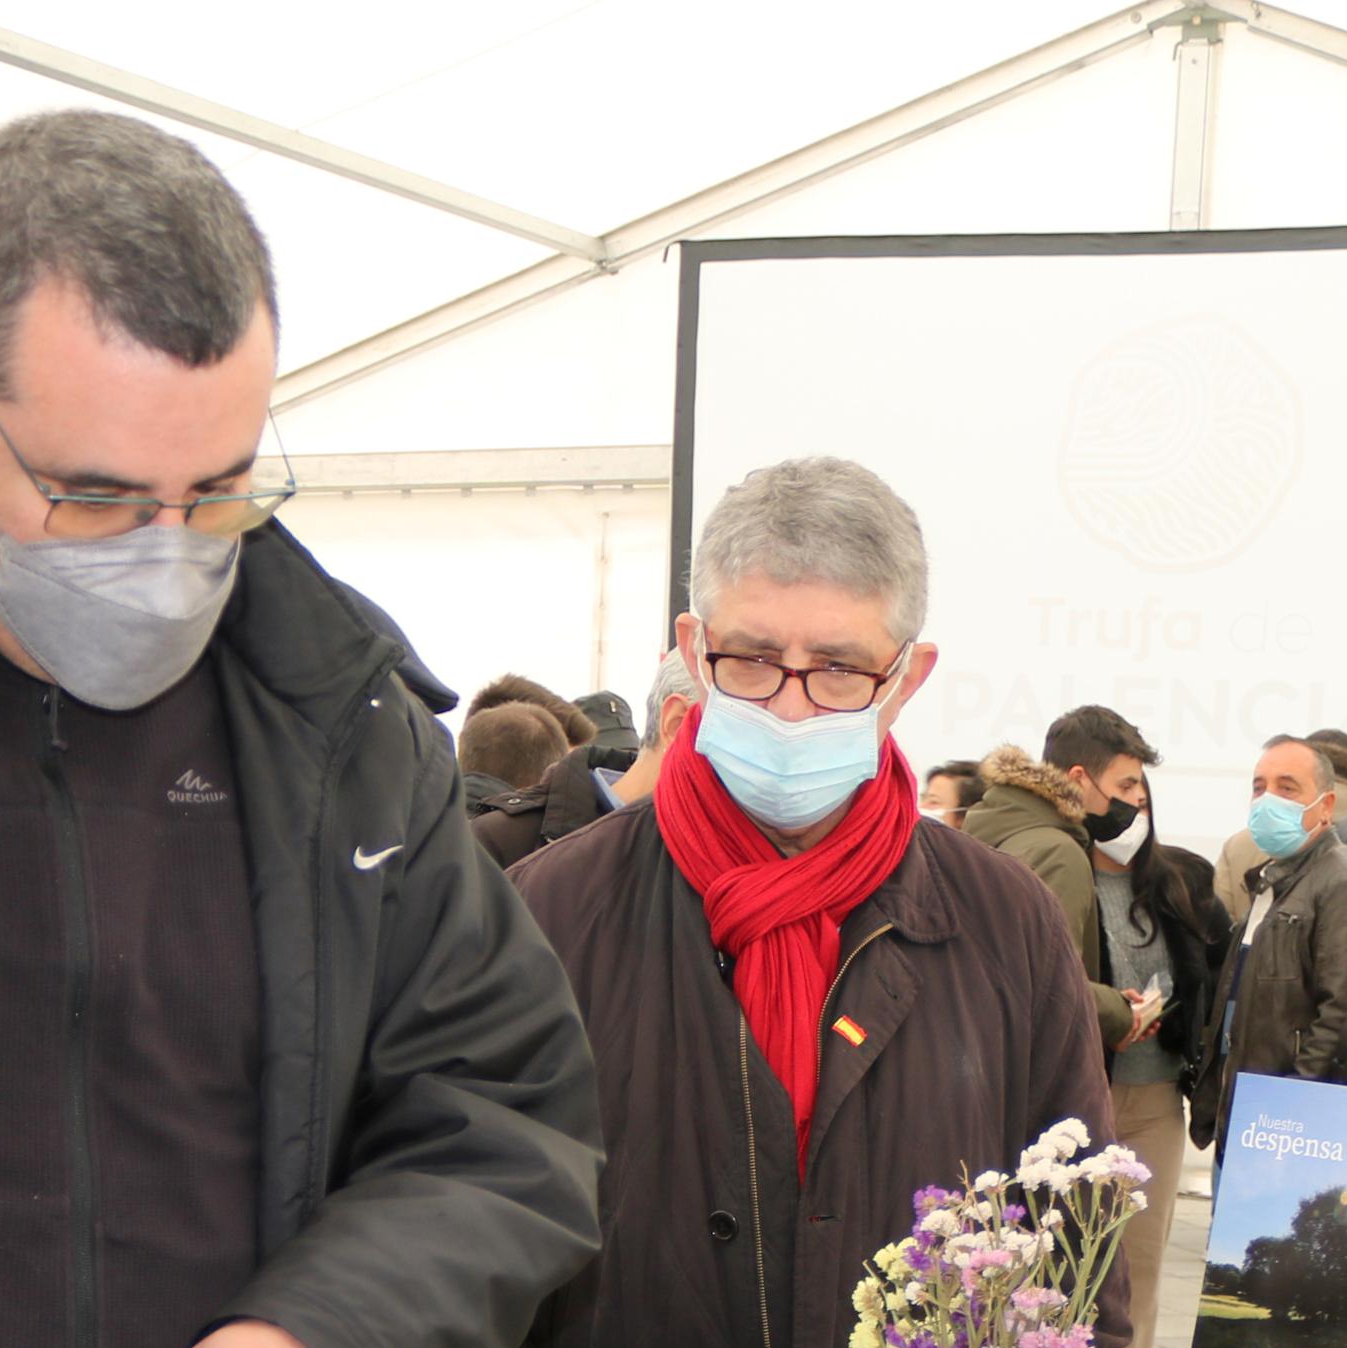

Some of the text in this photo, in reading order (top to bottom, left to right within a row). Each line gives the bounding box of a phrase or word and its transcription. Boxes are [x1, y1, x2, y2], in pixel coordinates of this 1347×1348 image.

[1029, 592, 1313, 661] Trufa de
[1240, 1122, 1345, 1161] despensa
[1258, 1113, 1305, 1133] Nuestra
